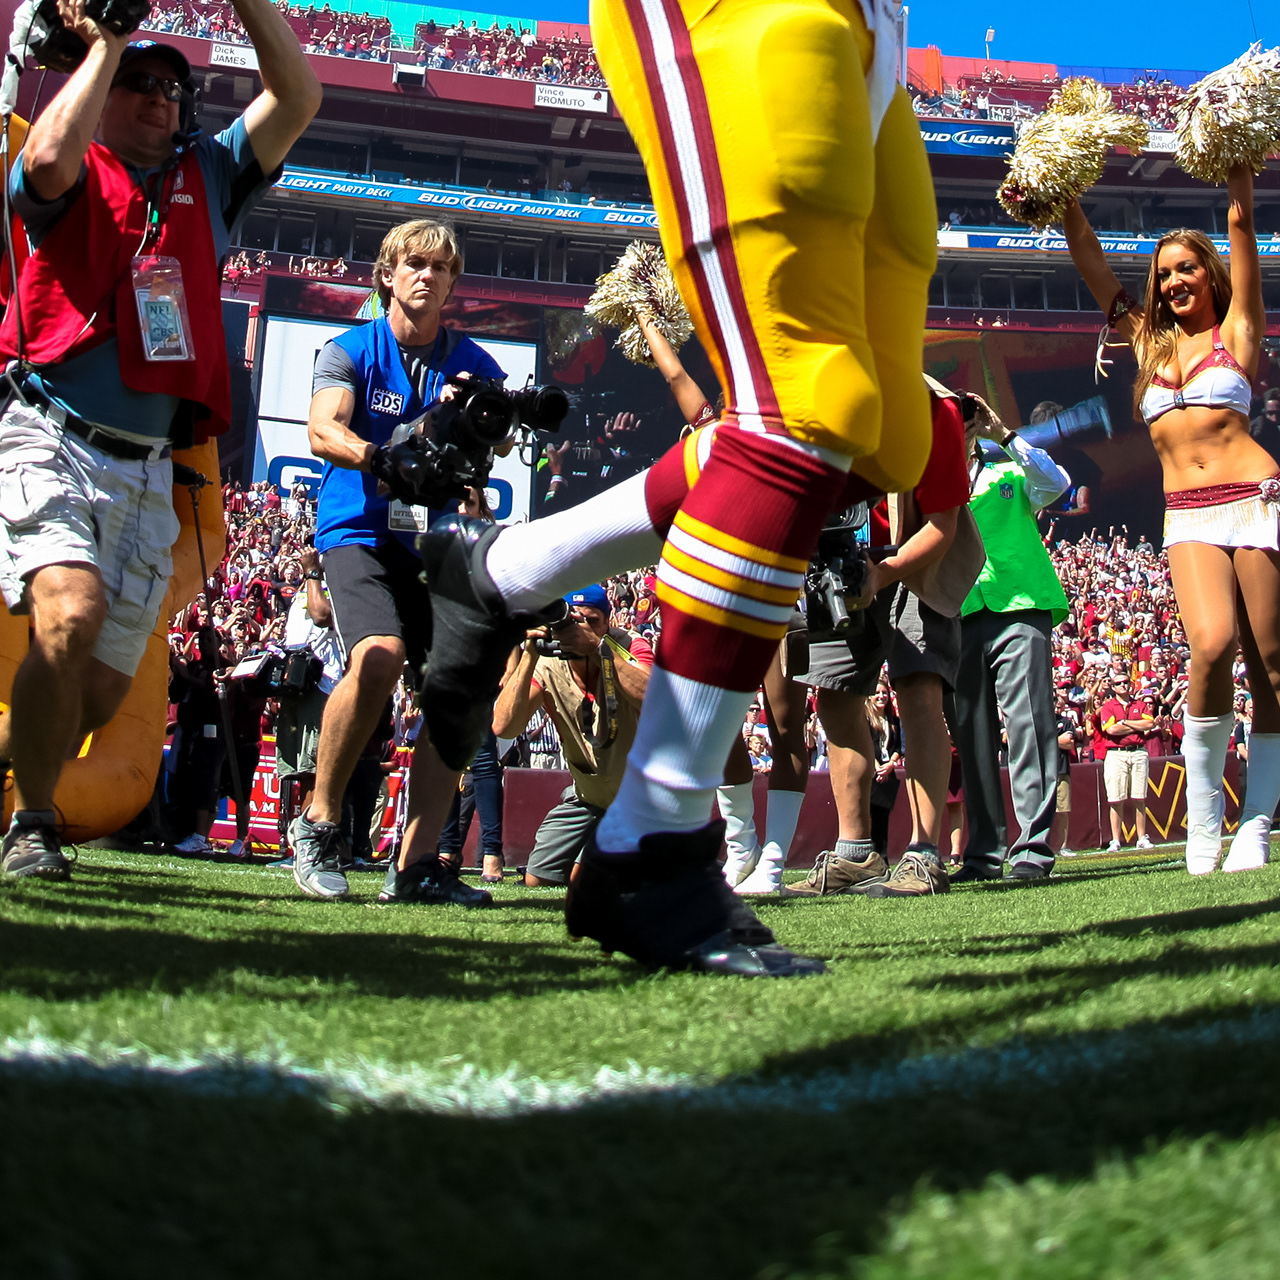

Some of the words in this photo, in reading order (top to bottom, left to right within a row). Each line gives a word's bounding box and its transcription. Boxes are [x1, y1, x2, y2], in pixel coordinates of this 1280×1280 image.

[213, 44, 236, 57] Dick
[212, 53, 247, 67] JAMES
[538, 86, 565, 97] Vince
[537, 94, 587, 108] PROMUTO
[955, 134, 1013, 146] LIGHT
[280, 175, 332, 192] LIGHT
[331, 183, 366, 196] PARTY
[366, 186, 393, 199] DECK
[417, 192, 460, 207] BUD
[465, 196, 522, 214] LIGHT
[521, 205, 556, 218] PARTY
[555, 208, 582, 220] DECK
[604, 212, 646, 224] BUD
[996, 237, 1034, 248] BUD
[1038, 238, 1069, 250] LIG
[1116, 242, 1139, 252] DECK
[150, 305, 172, 315] NFL
[153, 327, 174, 337] CBS
[372, 392, 403, 414] SDS
